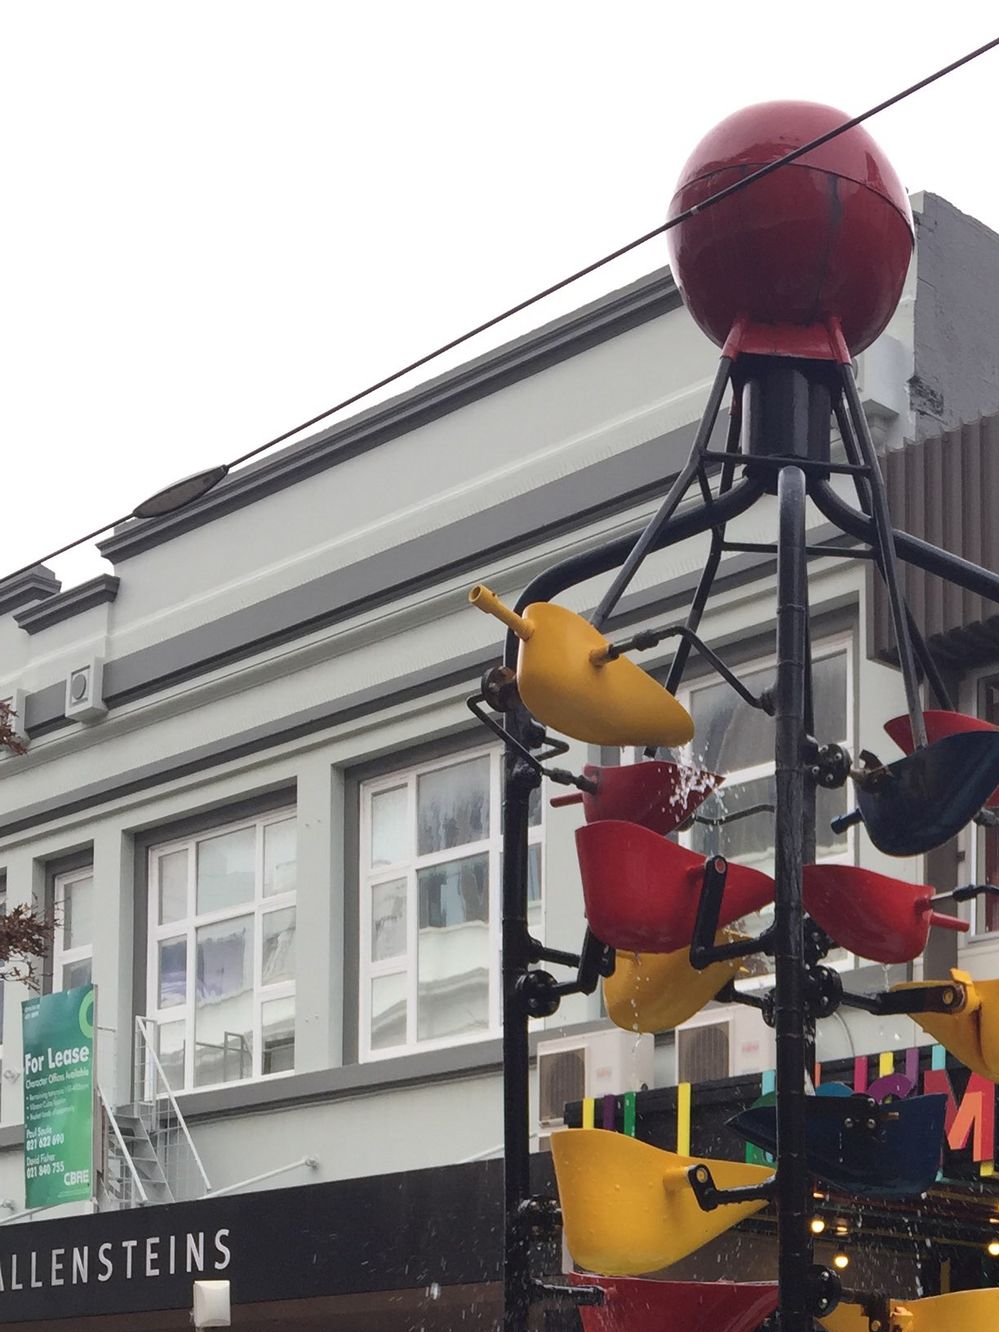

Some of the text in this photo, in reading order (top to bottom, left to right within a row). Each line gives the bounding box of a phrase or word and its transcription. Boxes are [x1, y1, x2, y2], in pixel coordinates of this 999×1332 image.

[24, 1045, 90, 1075] For Lease
[26, 1139, 37, 1151] 021
[26, 1166, 37, 1179] 021
[63, 1169, 90, 1186] CBRE
